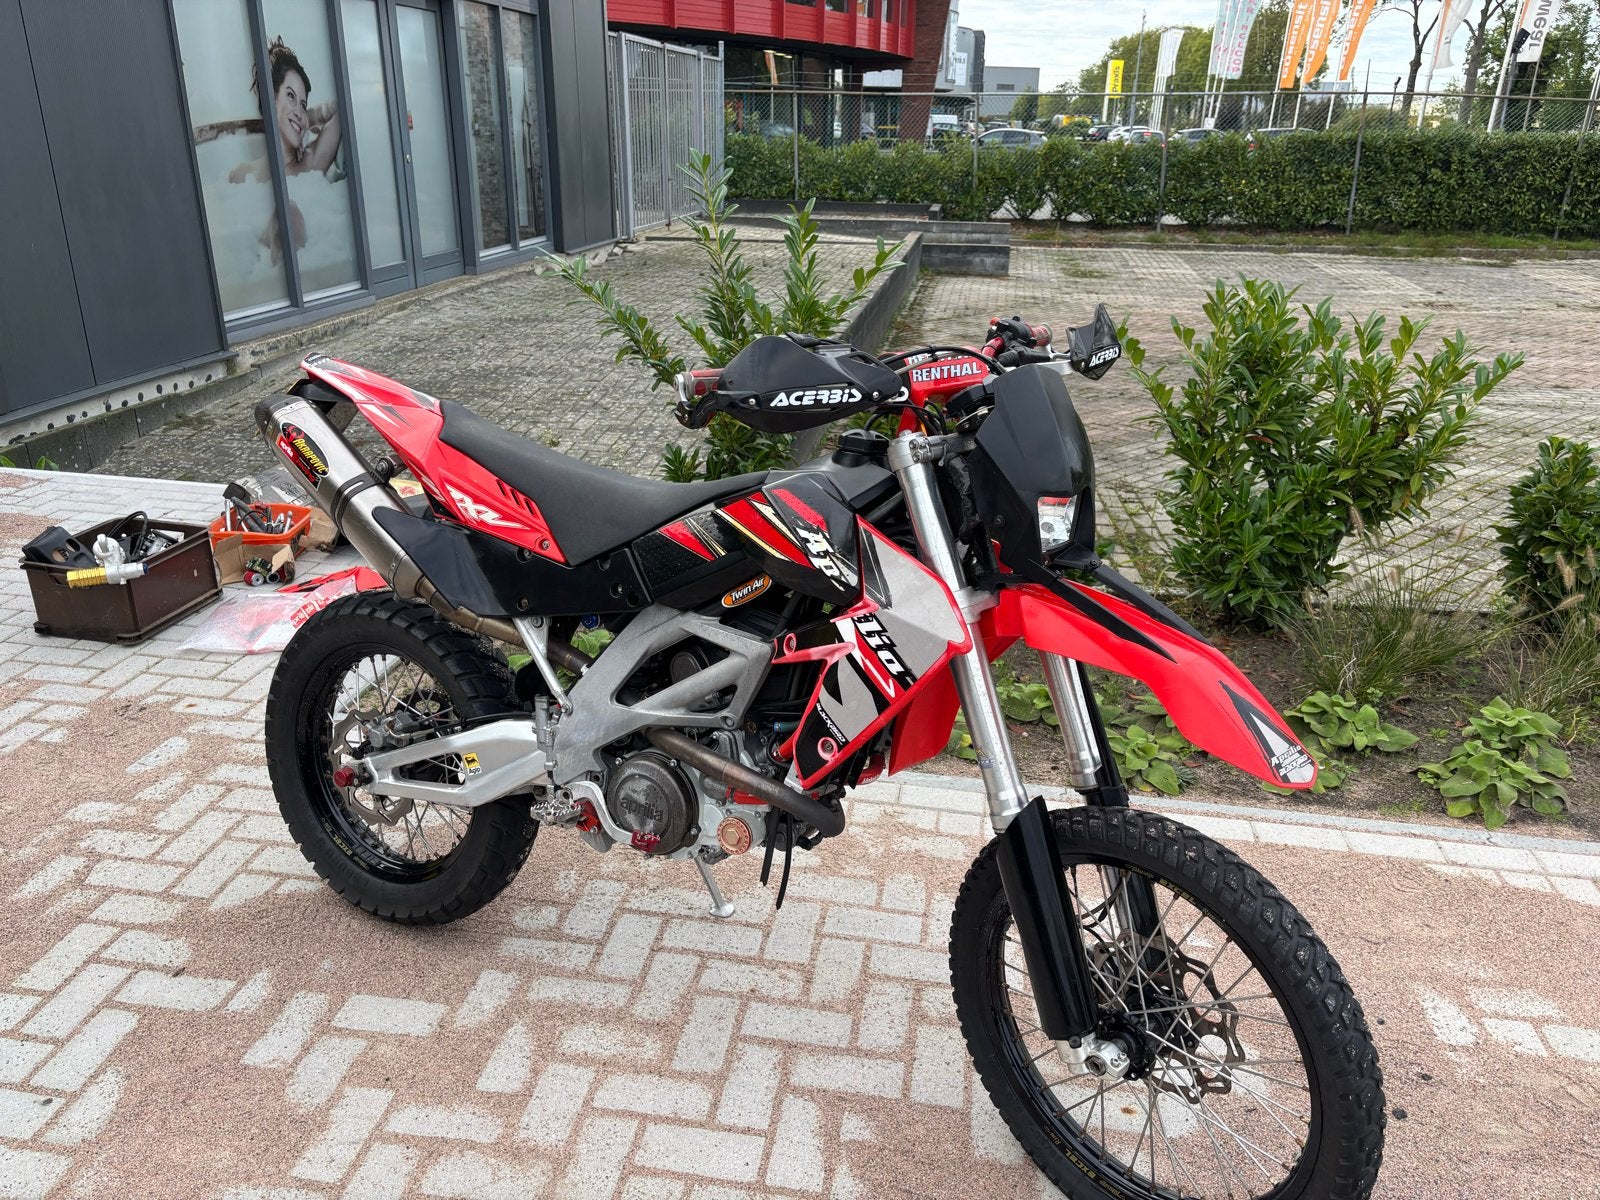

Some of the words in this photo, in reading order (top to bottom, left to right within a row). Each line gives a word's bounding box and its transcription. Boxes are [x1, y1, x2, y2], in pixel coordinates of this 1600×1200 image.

[912, 362, 982, 382] RENTHAL
[731, 585, 752, 602] Twin
[752, 577, 765, 591] Air
[1271, 744, 1302, 768] Aprilia
[620, 797, 665, 822] aprilia
[1064, 1147, 1097, 1179] EXCEL
